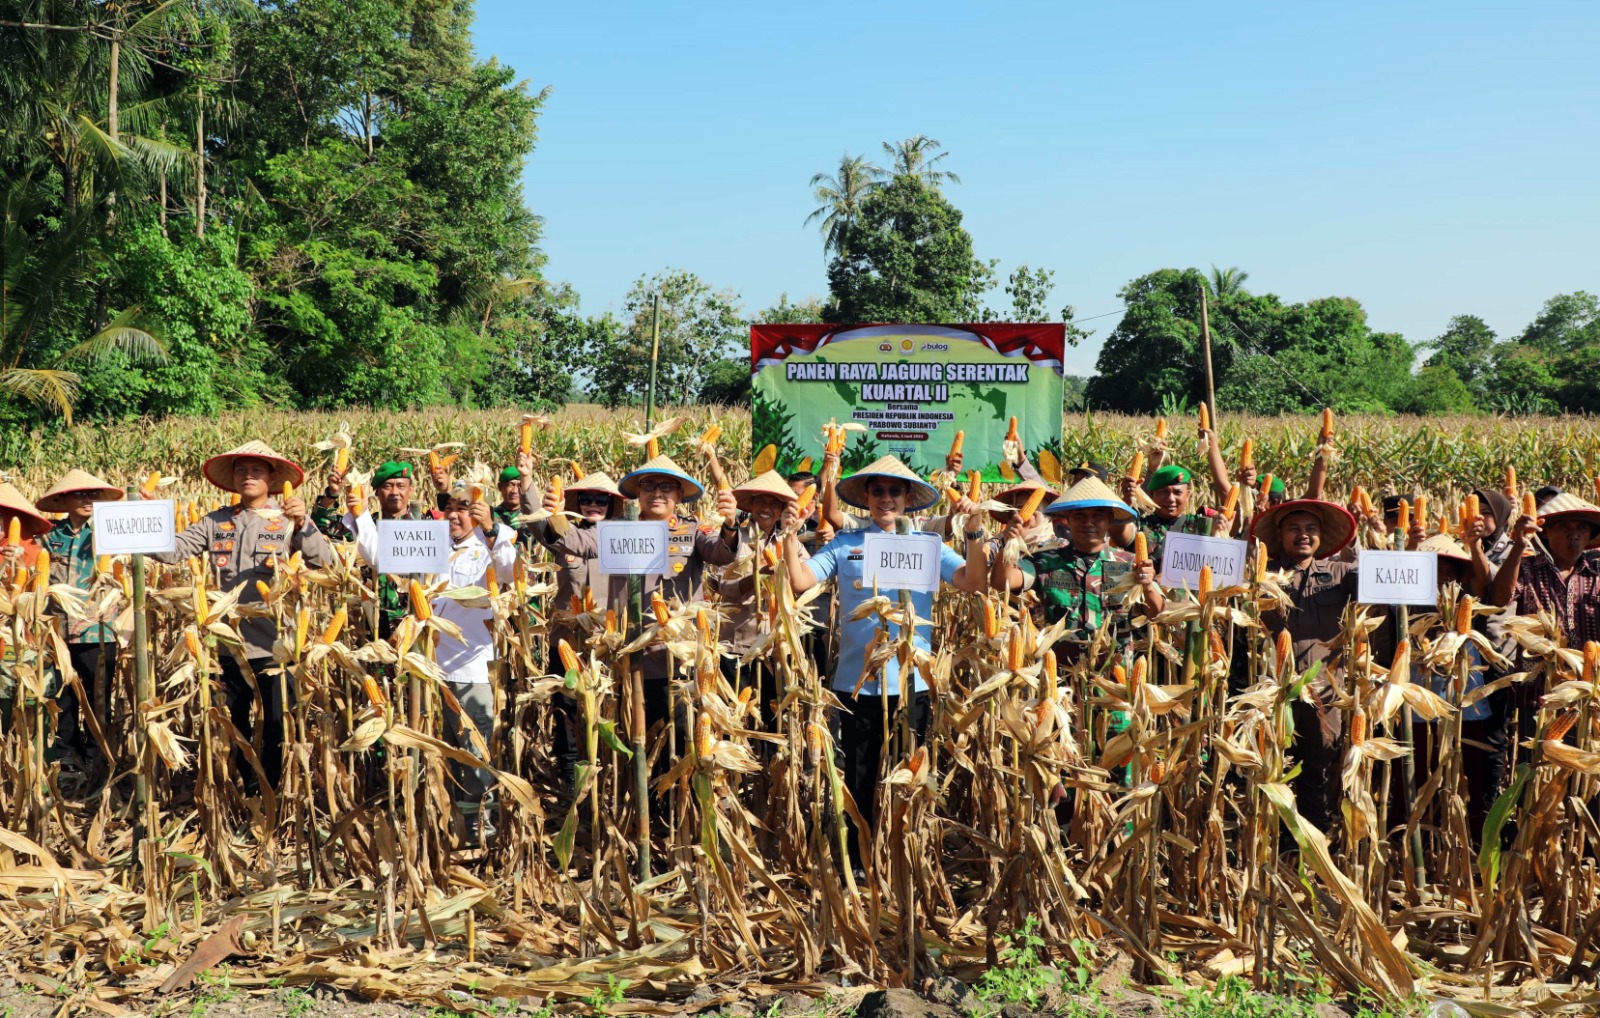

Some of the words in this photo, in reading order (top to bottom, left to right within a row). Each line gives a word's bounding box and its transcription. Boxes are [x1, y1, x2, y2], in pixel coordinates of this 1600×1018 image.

[927, 343, 948, 351] bulog
[787, 363, 836, 380] PANEN
[839, 363, 878, 380] RAYA
[880, 363, 943, 381] JAGUNG
[946, 364, 1028, 382] SERENTAK
[862, 383, 932, 401] KUARTAL
[935, 384, 947, 401] II
[852, 411, 884, 419] PRESIDEN
[885, 412, 916, 420] REPUBLIK
[918, 412, 954, 420] INDONESIA
[887, 403, 918, 411] Bersama
[868, 421, 902, 429] PRABOWO
[903, 421, 937, 430] SUBIANTO
[105, 517, 163, 535] WAKAPOLRES
[393, 530, 436, 541] WAKIL
[392, 546, 437, 557] BUPATI
[609, 538, 656, 555] KAPOLRES
[880, 551, 924, 571] BUPATI
[1172, 550, 1205, 573] DANDIM
[1375, 567, 1419, 585] KAJARI
